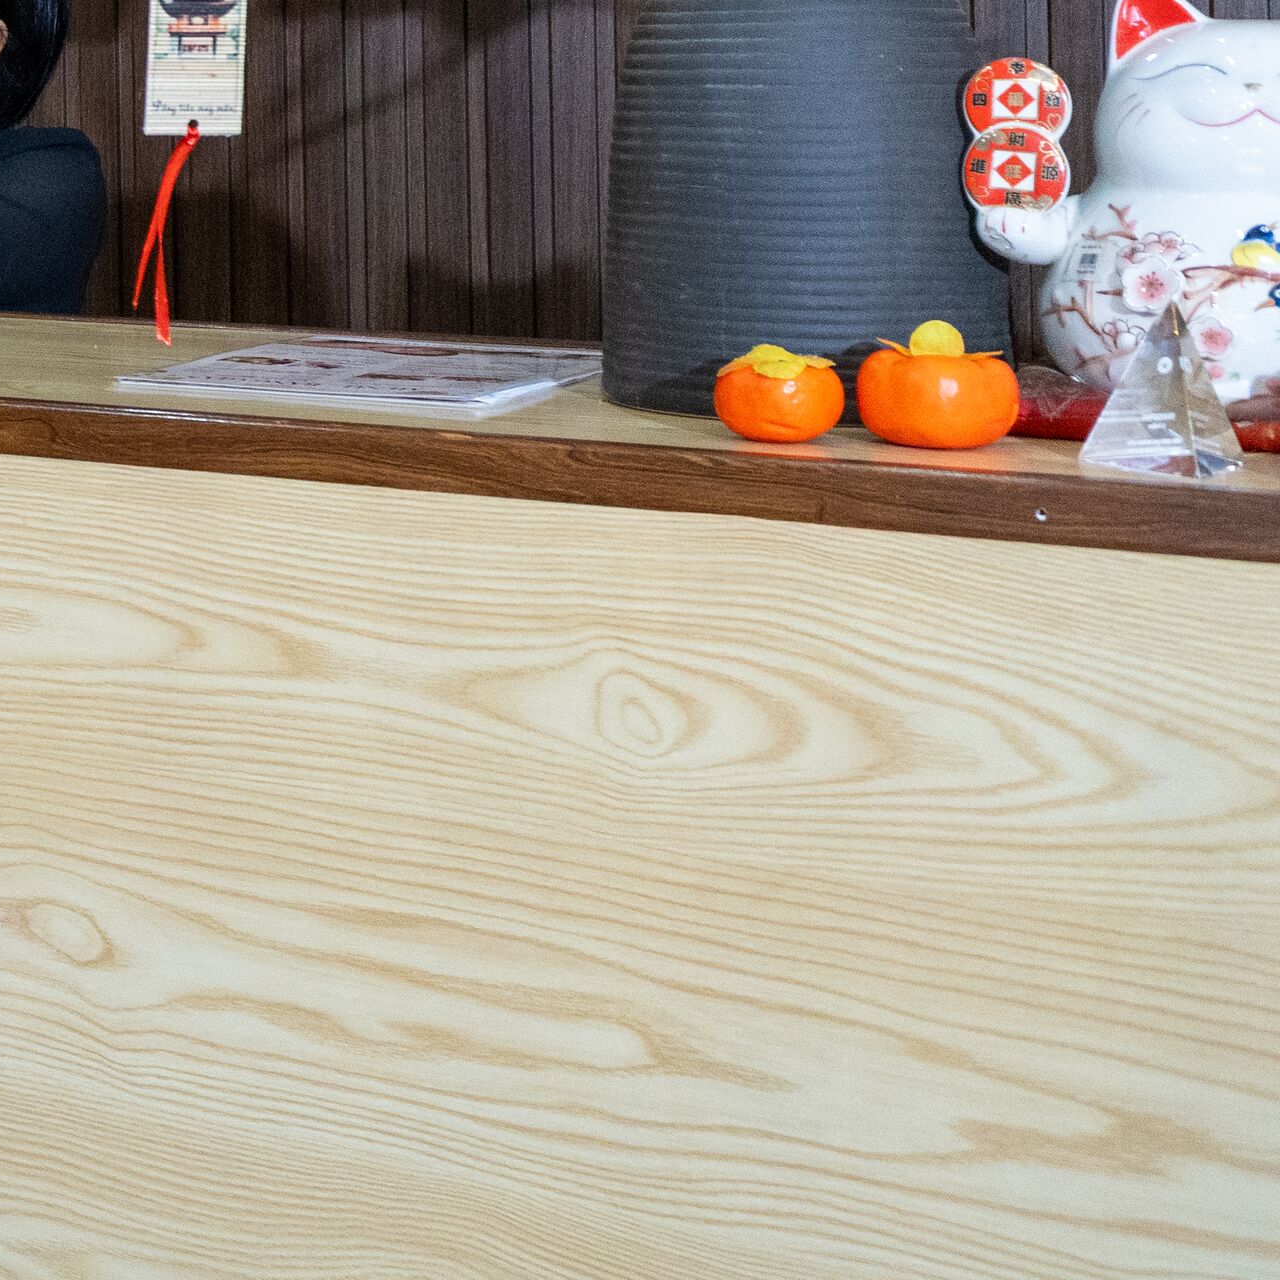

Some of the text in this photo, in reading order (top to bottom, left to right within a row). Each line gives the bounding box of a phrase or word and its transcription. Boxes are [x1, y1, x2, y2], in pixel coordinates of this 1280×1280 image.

[1008, 132, 1025, 146] 財
[971, 159, 986, 174] 進
[1042, 165, 1059, 180] 源
